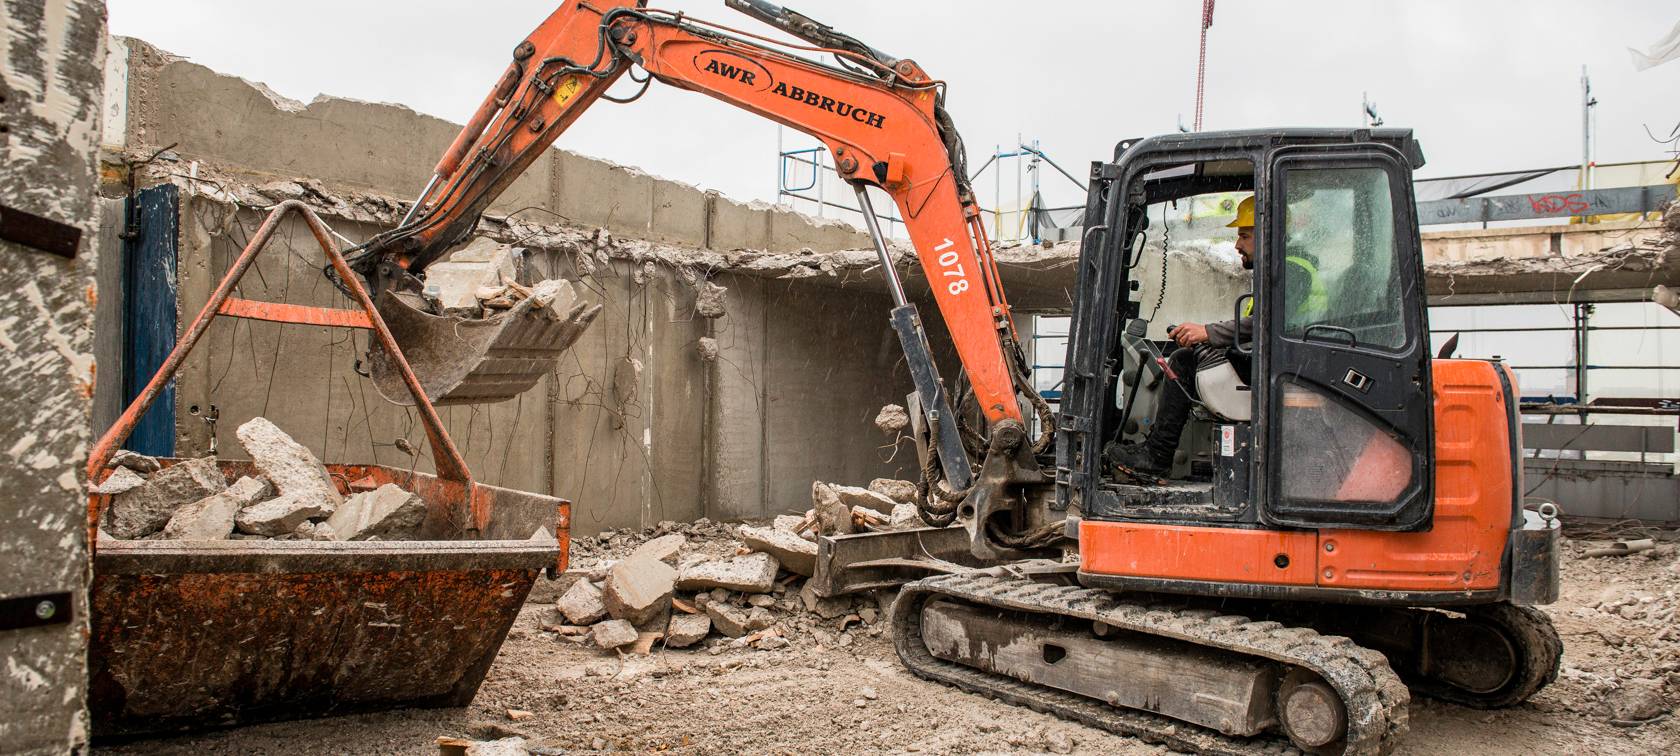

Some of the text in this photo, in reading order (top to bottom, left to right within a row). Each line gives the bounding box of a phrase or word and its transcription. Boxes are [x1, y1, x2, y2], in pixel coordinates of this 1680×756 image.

[704, 59, 886, 129] AWR ABBRUCH
[933, 238, 969, 295] 1078
